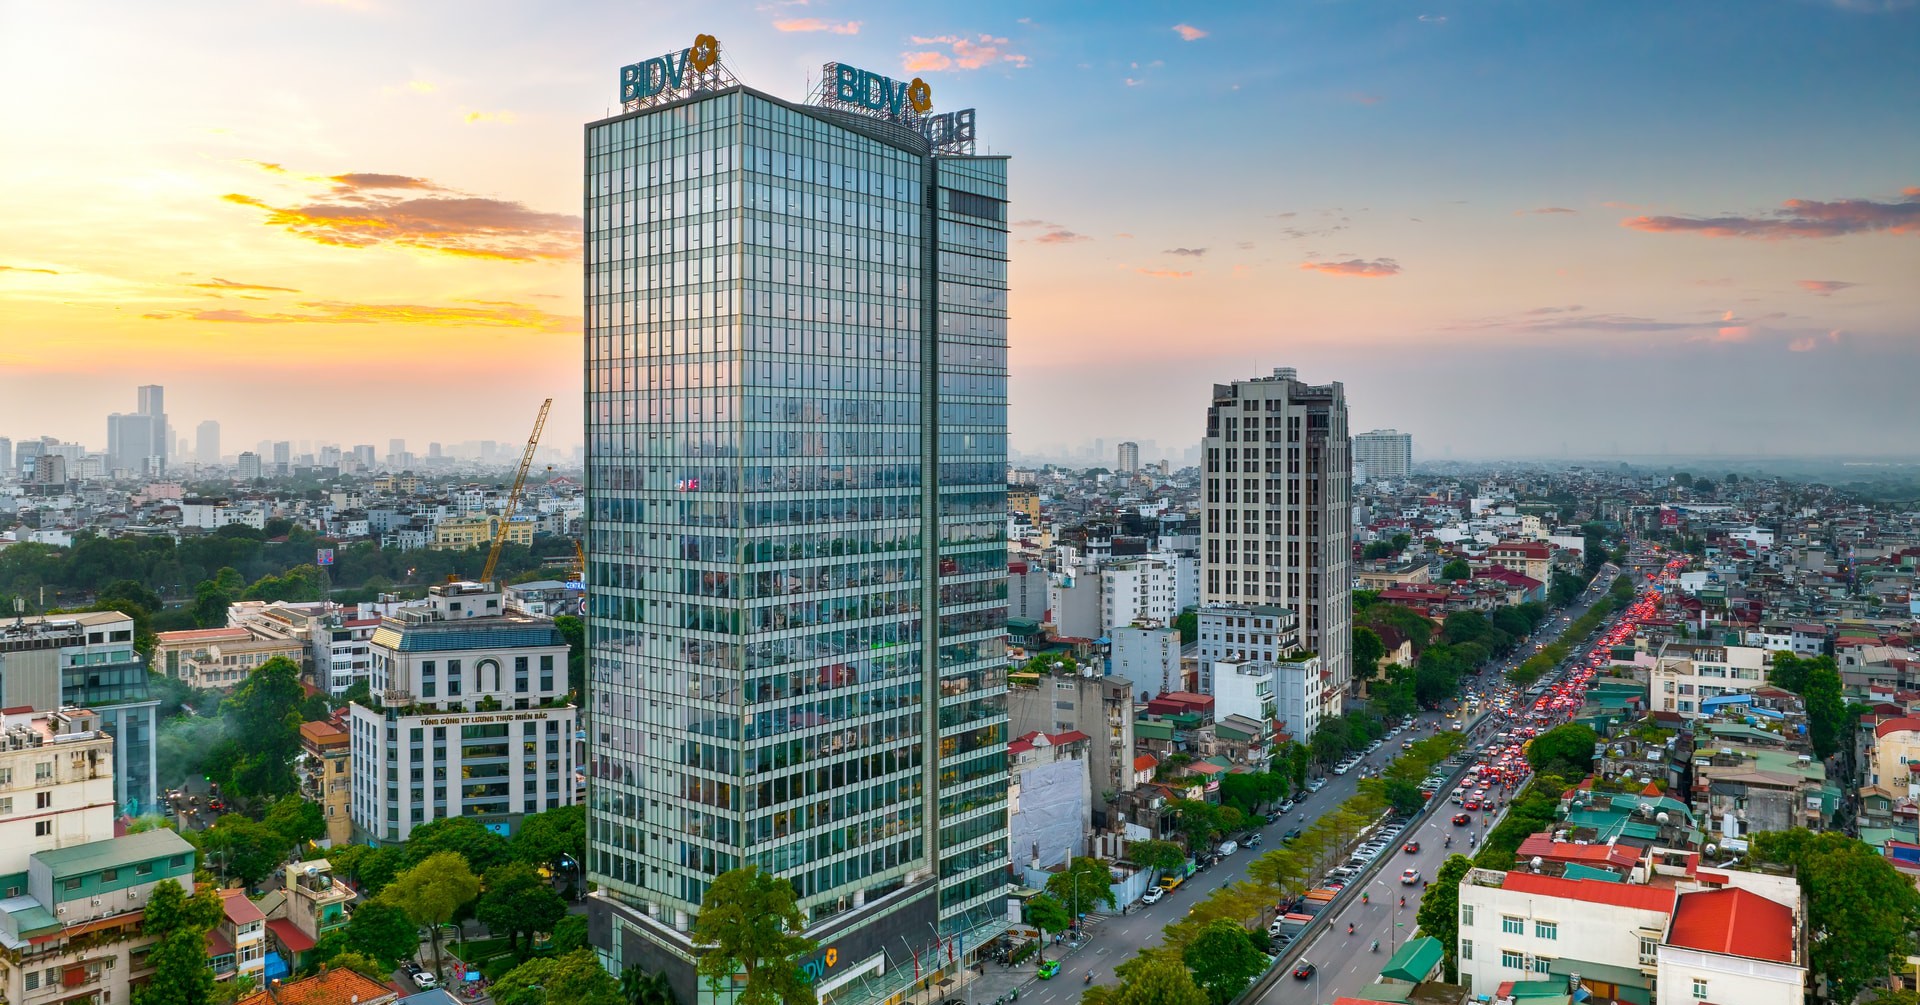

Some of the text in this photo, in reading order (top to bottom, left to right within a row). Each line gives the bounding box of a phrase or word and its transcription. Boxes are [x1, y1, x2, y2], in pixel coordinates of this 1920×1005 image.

[620, 47, 690, 104] BIDV
[837, 62, 908, 115] BIDV
[440, 716, 459, 725] CÔNG
